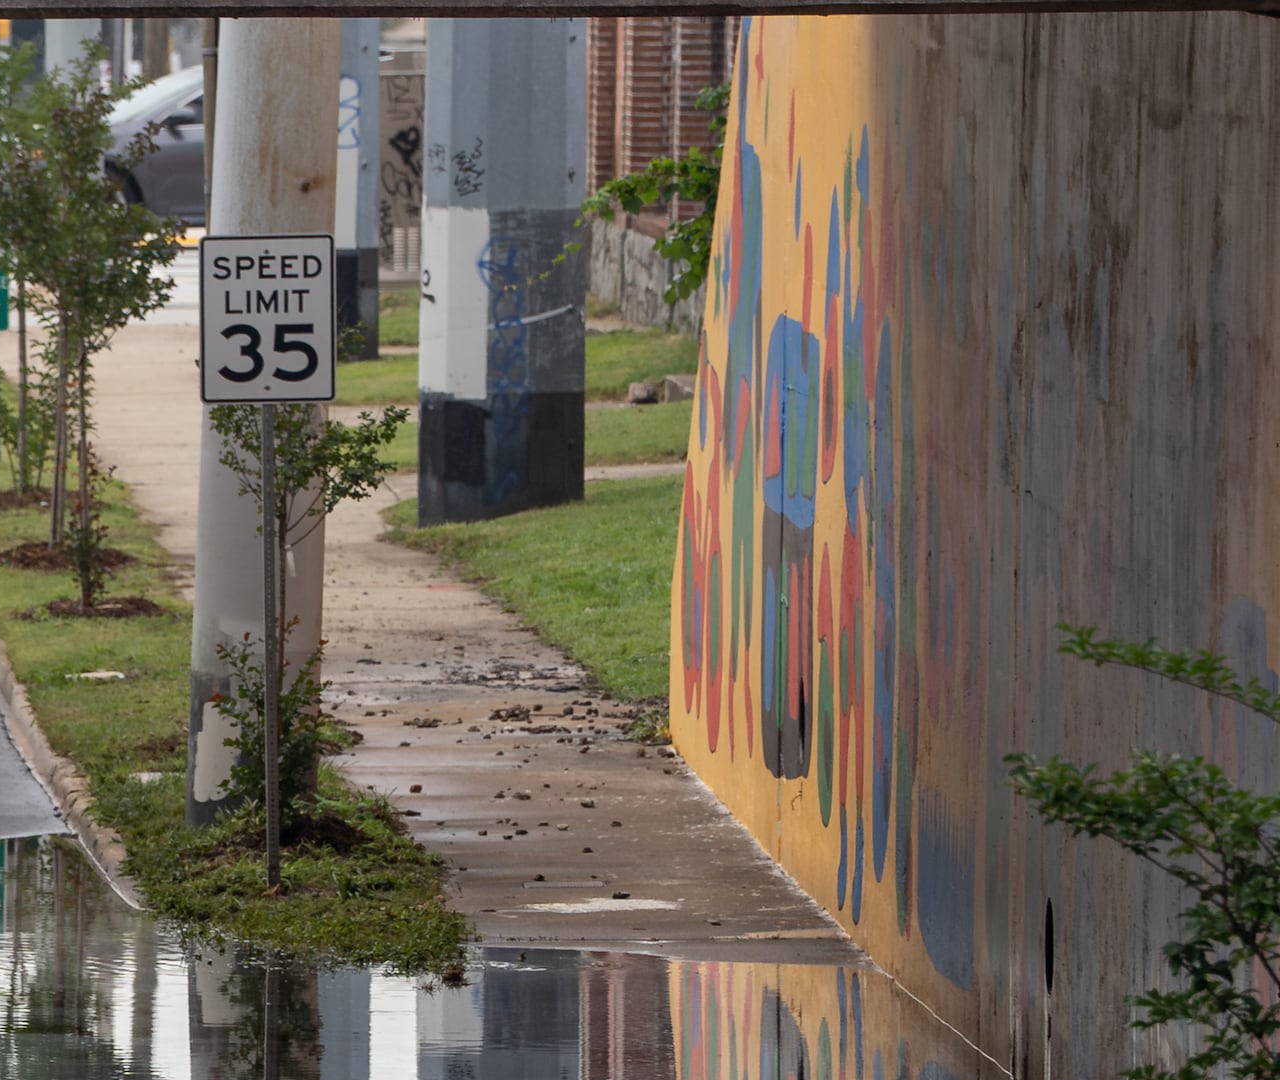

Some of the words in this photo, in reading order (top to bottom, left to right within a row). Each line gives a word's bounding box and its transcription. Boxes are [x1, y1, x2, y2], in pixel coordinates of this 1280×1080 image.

[212, 255, 322, 280] SPEED
[224, 289, 310, 314] LIMIT
[217, 323, 319, 383] 35
